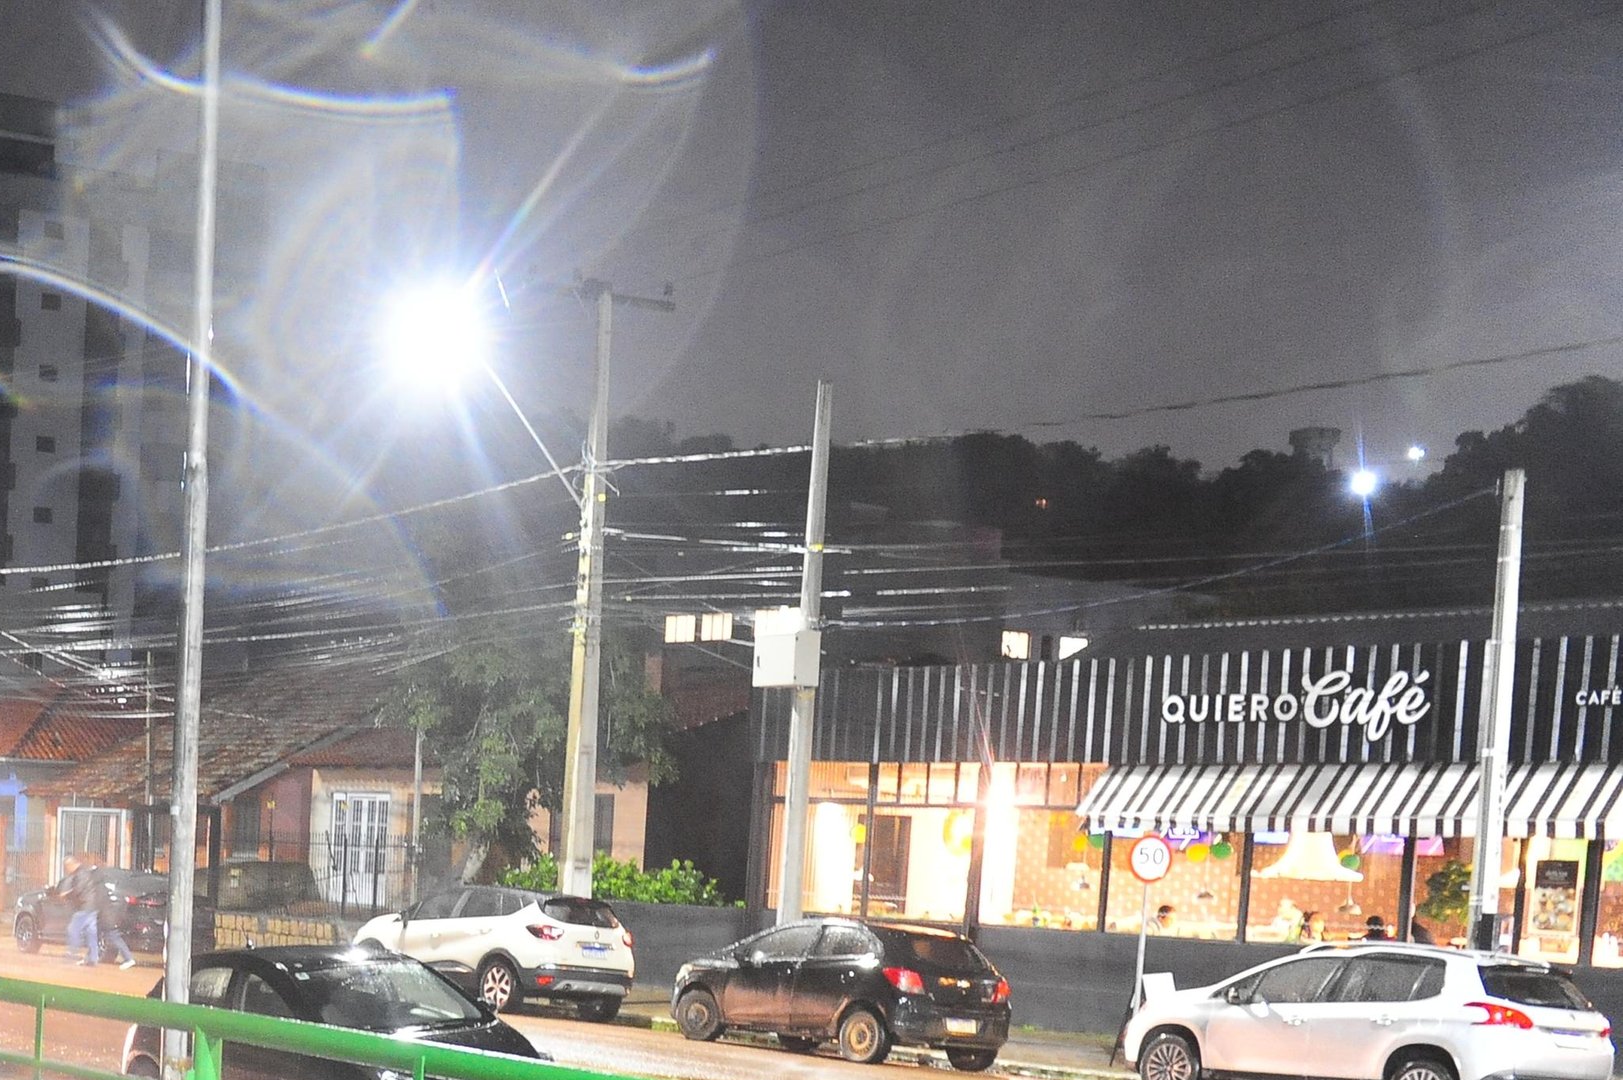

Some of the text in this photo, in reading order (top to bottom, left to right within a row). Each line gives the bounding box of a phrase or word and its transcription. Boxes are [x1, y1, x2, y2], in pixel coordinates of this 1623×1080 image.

[1161, 670, 1431, 742] QUIERO Café
[1575, 684, 1623, 706] CAFÉ
[1139, 847, 1164, 865] 50
